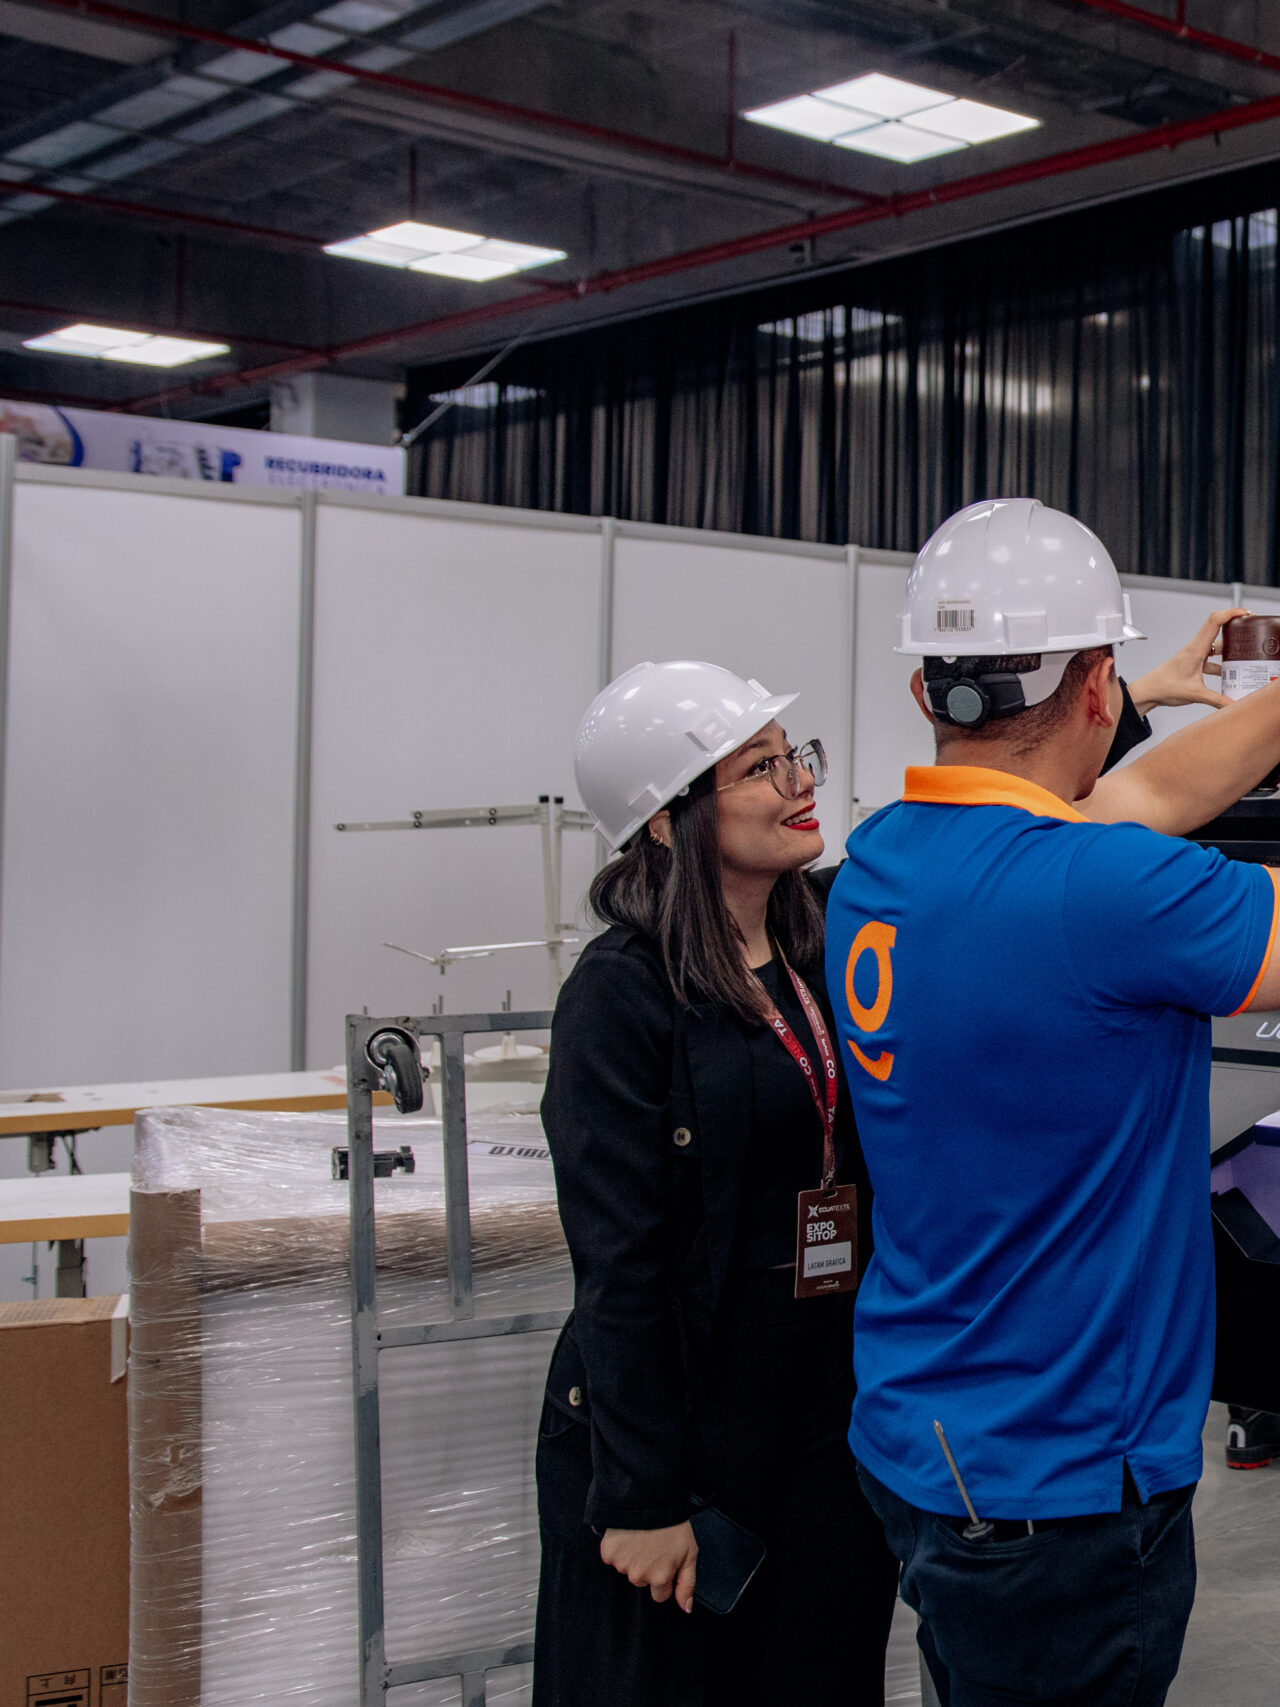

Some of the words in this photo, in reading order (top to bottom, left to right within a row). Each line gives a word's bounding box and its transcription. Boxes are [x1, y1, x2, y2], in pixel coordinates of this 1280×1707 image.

[264, 456, 386, 480] RECUBRIDORA
[806, 1220, 834, 1233] EXPO
[806, 1230, 837, 1243] SITOP
[808, 1262, 825, 1271] LATAM
